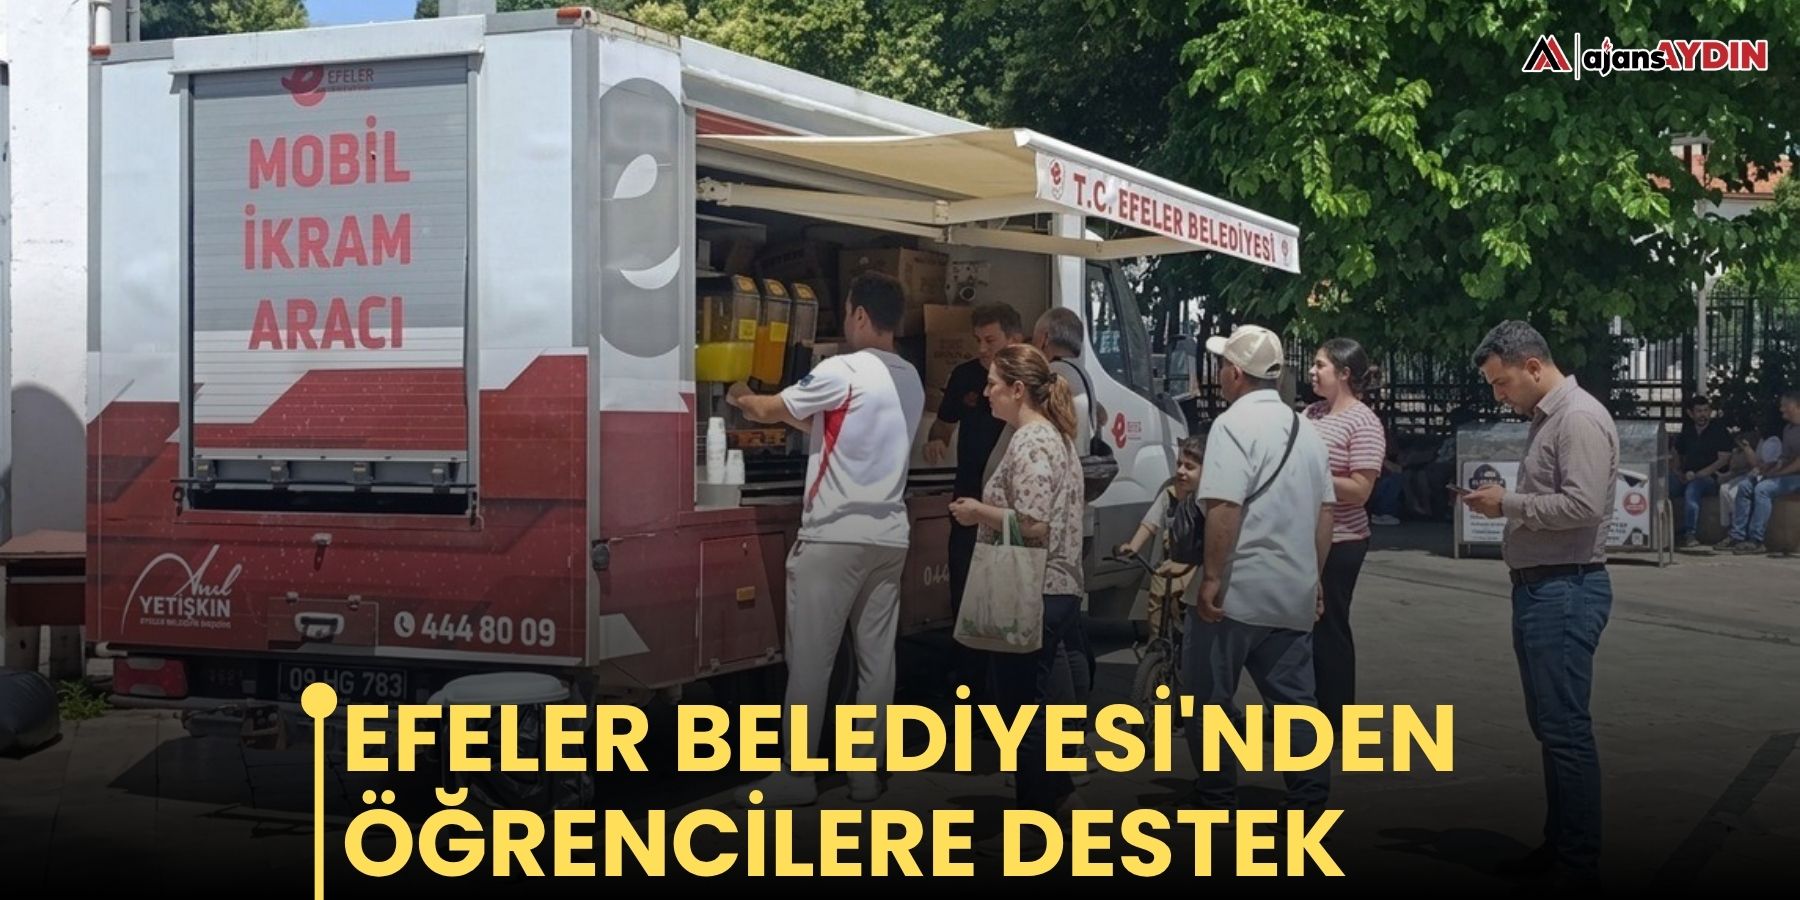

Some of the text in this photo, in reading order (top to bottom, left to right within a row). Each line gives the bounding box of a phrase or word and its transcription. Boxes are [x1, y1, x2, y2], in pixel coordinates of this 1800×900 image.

[327, 67, 375, 84] EFELER
[247, 115, 411, 189] MOBİL
[243, 203, 412, 270] İKRAM
[1073, 173, 1275, 263] T.C. EFELER BELEDİYESİ
[247, 295, 404, 350] ARACI
[421, 613, 557, 647] 444 80 09
[362, 672, 403, 699] 783
